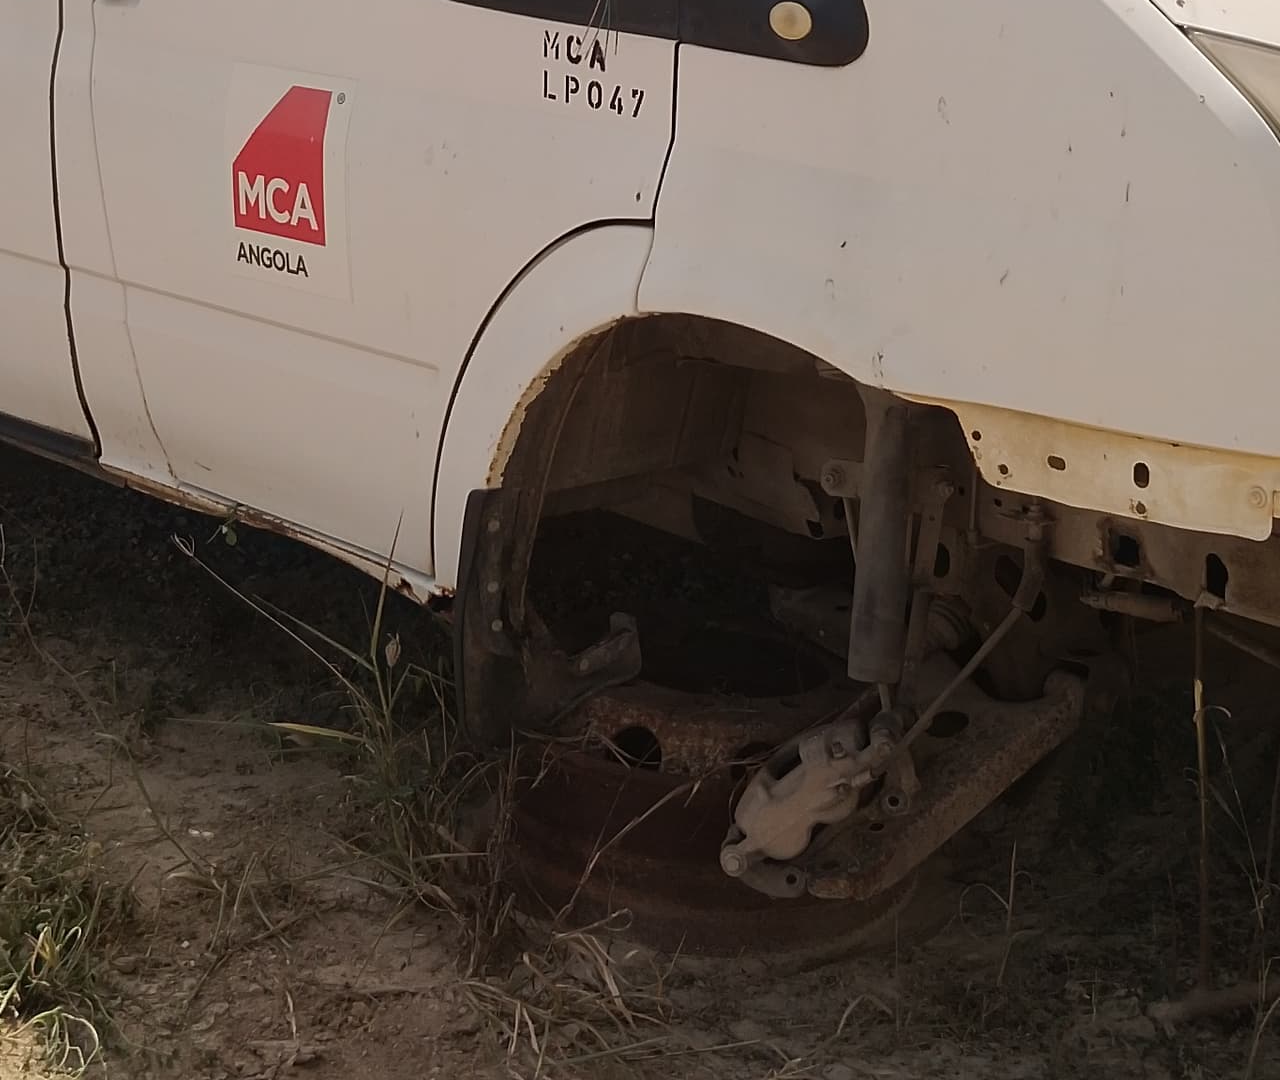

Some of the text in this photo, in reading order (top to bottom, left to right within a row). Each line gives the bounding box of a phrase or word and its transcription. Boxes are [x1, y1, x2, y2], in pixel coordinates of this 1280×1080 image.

[544, 30, 606, 72] MCA
[544, 70, 645, 118] LP047
[238, 171, 319, 231] MCA
[237, 242, 309, 278] ANGOLA
